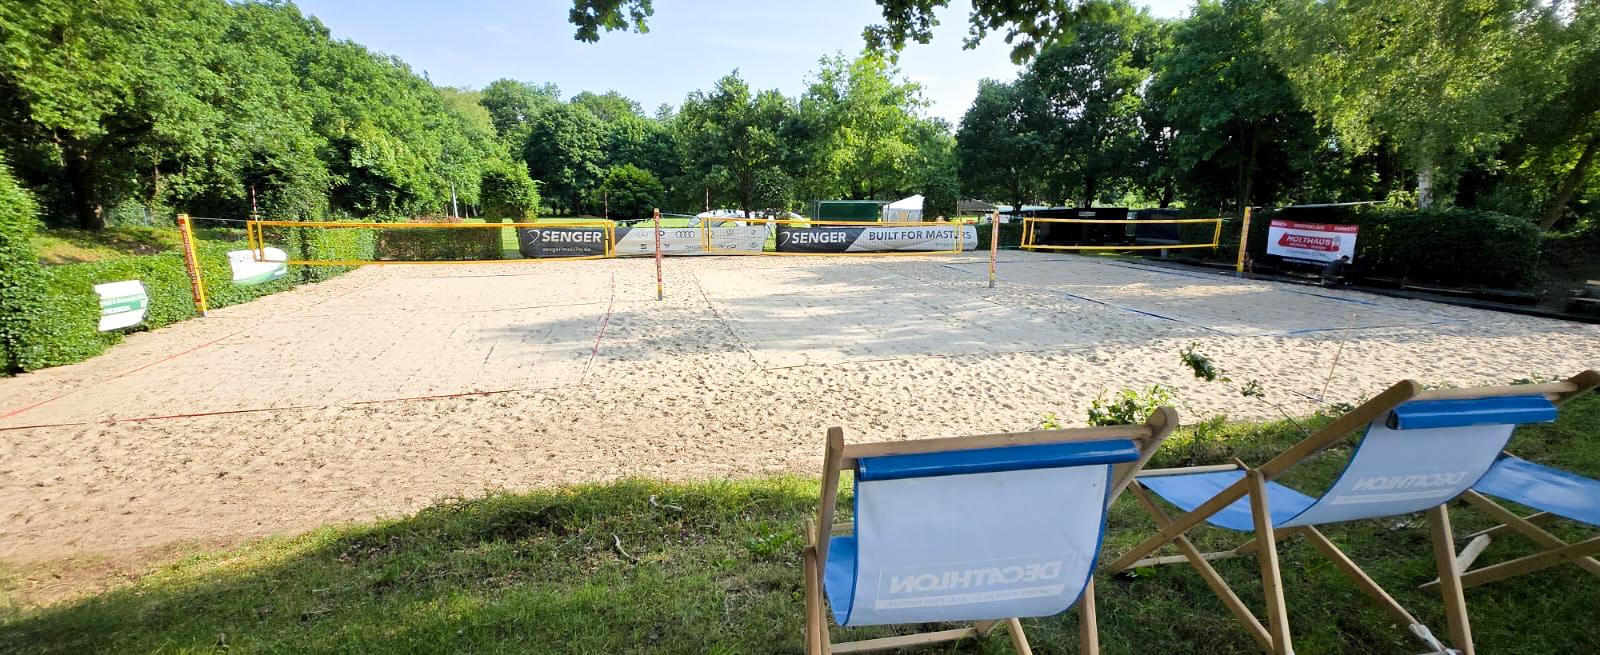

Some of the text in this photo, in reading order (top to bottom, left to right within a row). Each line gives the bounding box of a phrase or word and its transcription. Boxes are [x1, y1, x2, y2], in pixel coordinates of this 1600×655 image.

[541, 230, 602, 243] SENGER
[791, 231, 846, 244] SENGER
[869, 231, 898, 241] BUILT
[901, 231, 922, 240] FOR
[1286, 235, 1332, 246] HOLTHAUS
